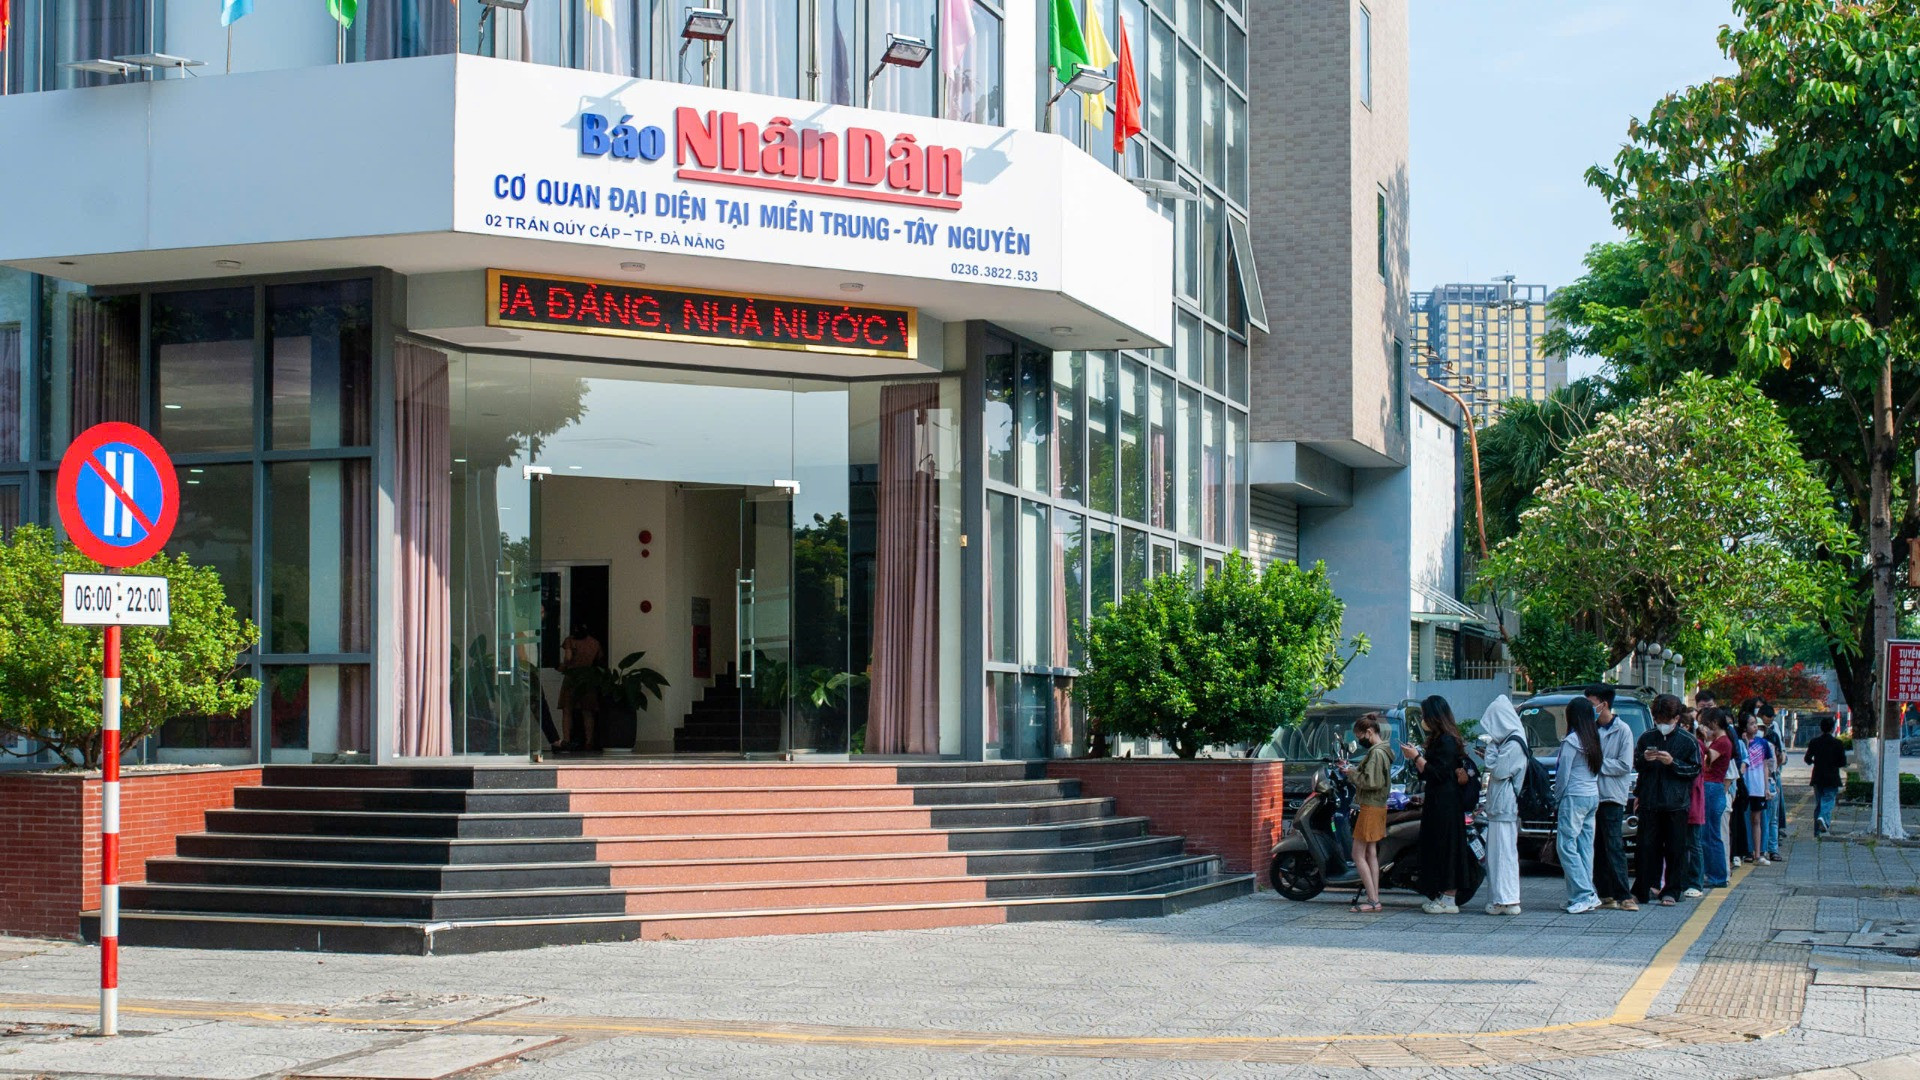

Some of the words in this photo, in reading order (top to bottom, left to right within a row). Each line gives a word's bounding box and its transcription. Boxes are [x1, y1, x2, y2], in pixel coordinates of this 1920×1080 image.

[582, 112, 665, 160] Báo
[676, 106, 839, 181] Nhân
[847, 127, 962, 196] Dân
[485, 214, 502, 227] 02
[634, 230, 657, 243] TP.
[661, 231, 680, 246] ĐÀ
[494, 173, 525, 201] CƠ
[537, 179, 600, 209] QUAN
[608, 187, 646, 218] ĐẠI
[655, 190, 706, 224] DIỆN
[715, 198, 749, 229] TẠI
[760, 199, 813, 233] MIỀN
[948, 226, 1030, 256] NGUYÊN
[951, 262, 1038, 282] 0236.3822.533
[683, 297, 763, 336] NHÀ
[773, 306, 888, 345] NƯỚC
[75, 585, 112, 611] 06:00
[127, 586, 162, 612] 22:00
